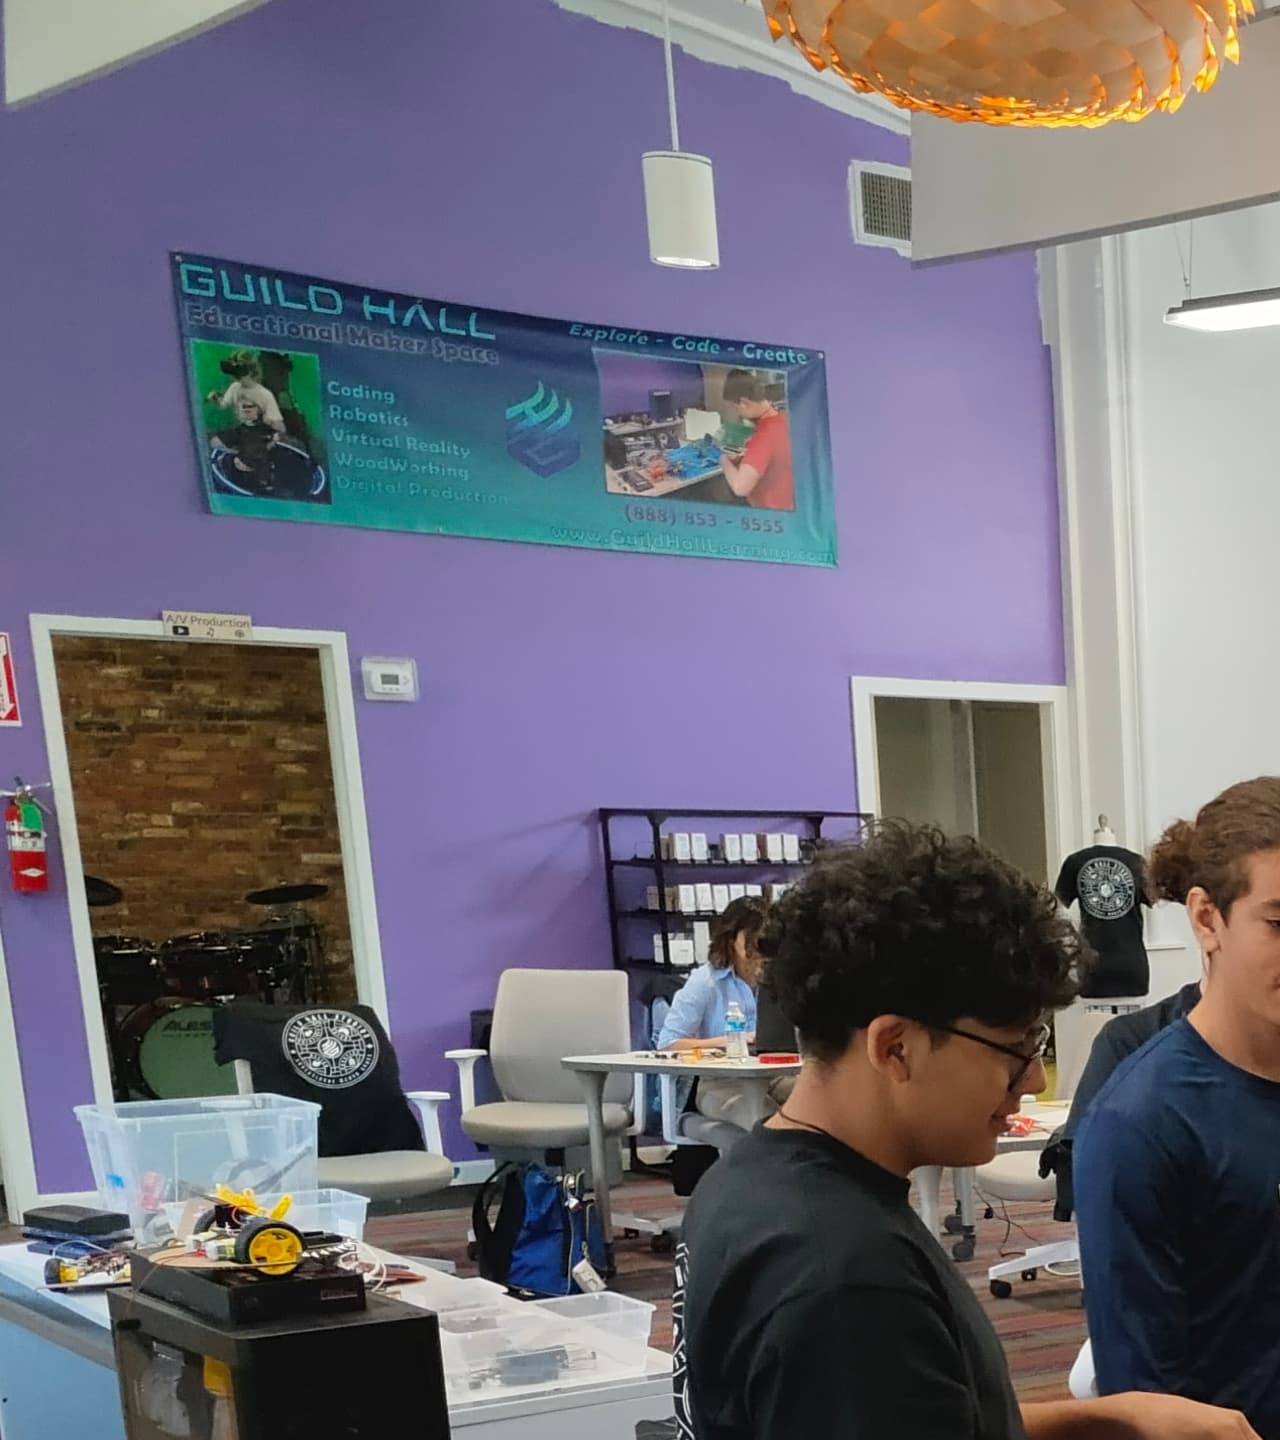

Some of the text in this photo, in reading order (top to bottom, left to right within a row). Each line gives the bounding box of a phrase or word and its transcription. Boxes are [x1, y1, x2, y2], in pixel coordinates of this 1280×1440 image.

[180, 263, 496, 340] GUILD HALL
[184, 302, 499, 364] Educational Maker Space
[569, 323, 648, 345] Explore
[671, 335, 720, 355] Code
[742, 343, 808, 365] Create
[327, 380, 395, 404] Coding
[329, 404, 409, 428] Robotics
[332, 428, 471, 458] Virtual Reality
[336, 475, 509, 505] Digital Production
[166, 614, 250, 628] A/V Production
